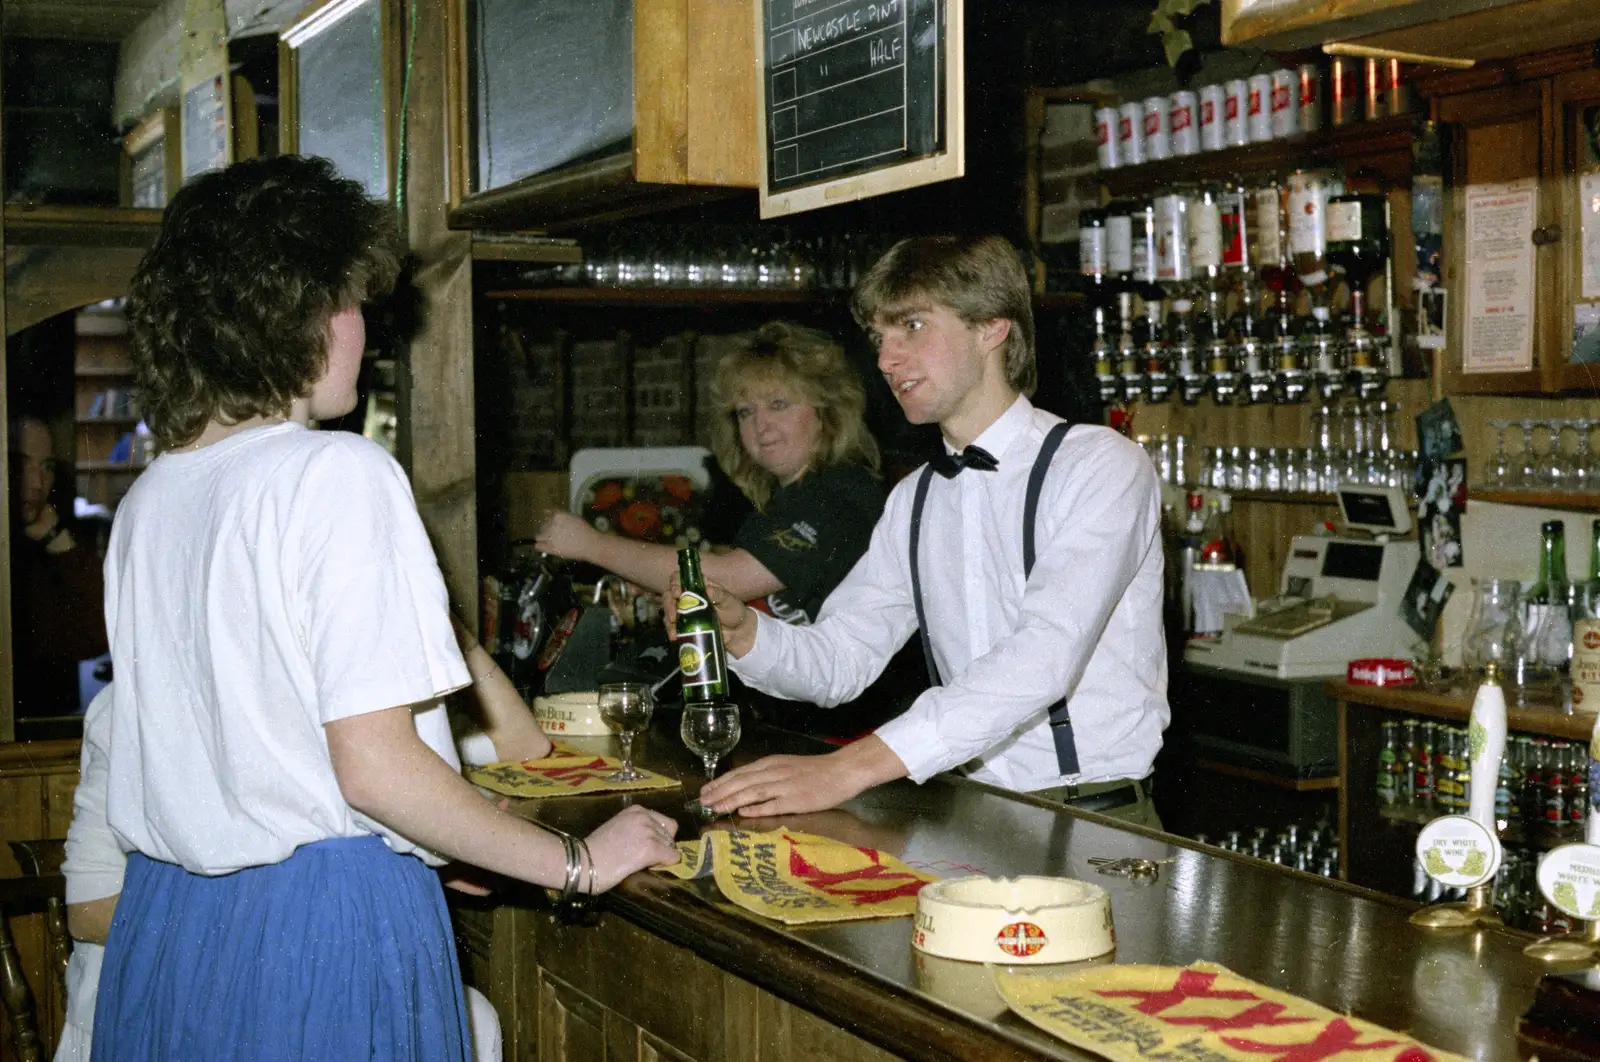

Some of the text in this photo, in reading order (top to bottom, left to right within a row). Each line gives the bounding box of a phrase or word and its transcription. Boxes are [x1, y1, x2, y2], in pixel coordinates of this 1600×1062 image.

[797, 0, 898, 51] NEWCASTLE PINT
[869, 38, 902, 67] HALF
[1432, 839, 1478, 847] DRY WHITE
[1444, 848, 1465, 857] WINE
